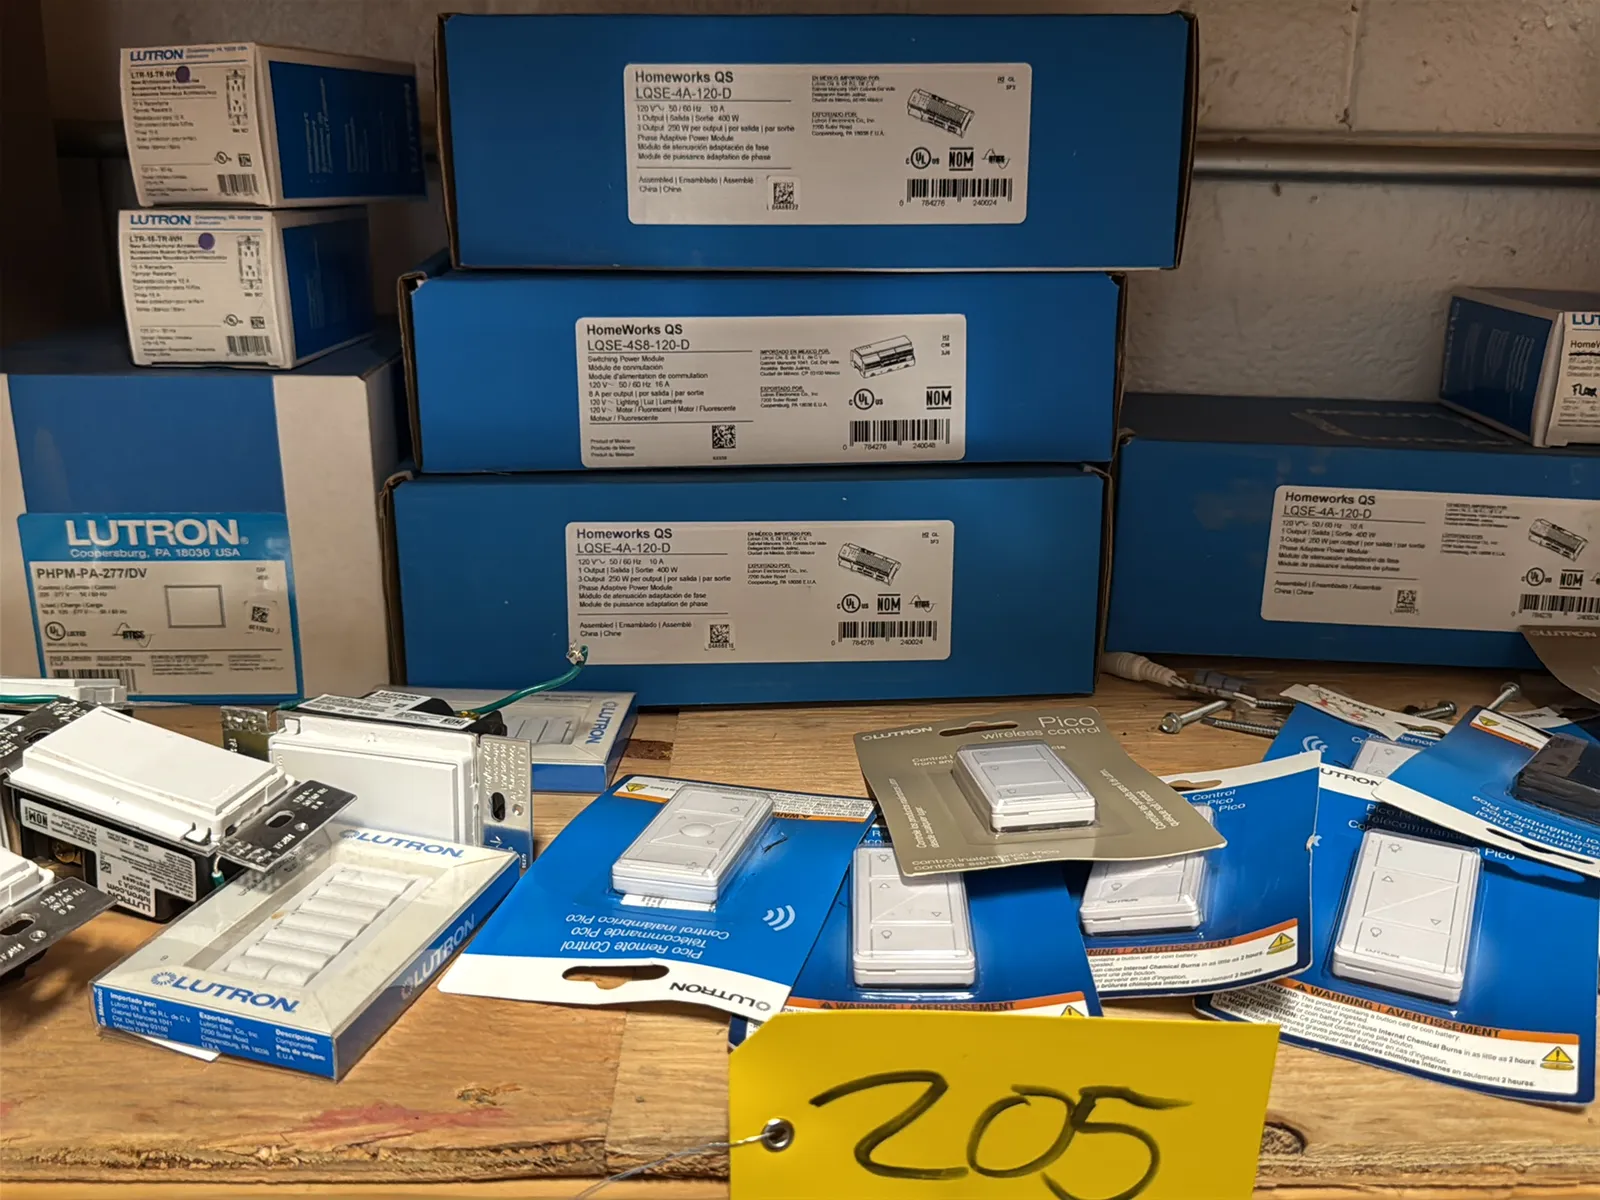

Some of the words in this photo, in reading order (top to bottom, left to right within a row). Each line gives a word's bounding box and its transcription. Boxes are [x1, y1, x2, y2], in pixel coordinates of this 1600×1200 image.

[130, 49, 184, 61] LUTRON
[635, 71, 710, 83] Homeworks
[715, 71, 733, 83] QS
[635, 88, 731, 99] LQSE-4A-120-D
[660, 135, 687, 143] Adaptive
[707, 153, 740, 161] adaptation
[752, 153, 771, 161] phase
[949, 152, 973, 167] NOM
[130, 215, 191, 225] LUTRON
[1572, 313, 1600, 325] LUT
[587, 324, 660, 335] HomeWorks
[665, 324, 682, 335] QS
[588, 340, 690, 350] LQSE-4S8-120-D
[927, 390, 952, 405] NOM
[1285, 492, 1354, 504] Homeworks
[1358, 495, 1376, 505] QS
[1283, 506, 1371, 518] LQSE-4A-120-D
[65, 519, 240, 546] LUTRON
[577, 529, 650, 538] Homeworks
[654, 528, 672, 539] QS
[70, 549, 150, 559] Coopersburg,
[155, 549, 171, 557] PA
[176, 548, 210, 557] 18036
[215, 548, 240, 557] USA
[577, 543, 670, 553] LQSE-4A-120-D
[37, 568, 147, 579] PHPM-PA-277/DV
[1560, 573, 1583, 586] NOM
[877, 596, 900, 611] NOM
[586, 708, 616, 745] LUTRON
[1038, 716, 1095, 728] Pico
[873, 726, 932, 740] LUTRON
[982, 729, 1043, 741] wireless
[1047, 727, 1100, 736] control
[912, 754, 948, 763] Control
[1321, 768, 1382, 786] UTRON
[1192, 789, 1236, 802] Control
[1207, 797, 1233, 805] Pico
[1219, 803, 1246, 812] Pico
[1473, 795, 1499, 811] Pico
[1476, 811, 1523, 833] Control
[357, 833, 464, 857] LUTRON
[1485, 849, 1515, 860] Pico
[914, 863, 965, 871] contrôle
[106, 882, 151, 904] lutron.com
[566, 914, 595, 924] Pico
[600, 915, 677, 933] inalámbrico
[571, 927, 601, 937] Pico
[604, 928, 706, 948] Télécommande
[681, 927, 730, 940] Control
[412, 912, 477, 988] LUTRON
[560, 940, 610, 953] Control
[614, 941, 668, 954] Remote
[672, 947, 703, 959] Pico
[110, 992, 142, 1005] Importado
[175, 975, 300, 1014] LUTRON
[669, 982, 757, 1007] LUTRON
[910, 1001, 1015, 1011] AVERTISSEMENT
[1269, 984, 1299, 998] HAZARD:
[1302, 995, 1319, 1003] This
[1315, 999, 1340, 1011] product
[1342, 1006, 1369, 1018] contains
[1376, 1013, 1398, 1026] button
[1420, 1026, 1434, 1034] coin
[1310, 983, 1372, 1010] WARNING
[1383, 1007, 1500, 1038] AVERTISSEMENT
[233, 1035, 248, 1043] Road
[1379, 1027, 1405, 1040] Internal
[1406, 1035, 1439, 1050] Chemical
[1441, 1045, 1462, 1055] Burns
[1482, 1053, 1497, 1061] little
[809, 1070, 1194, 1200] 205
